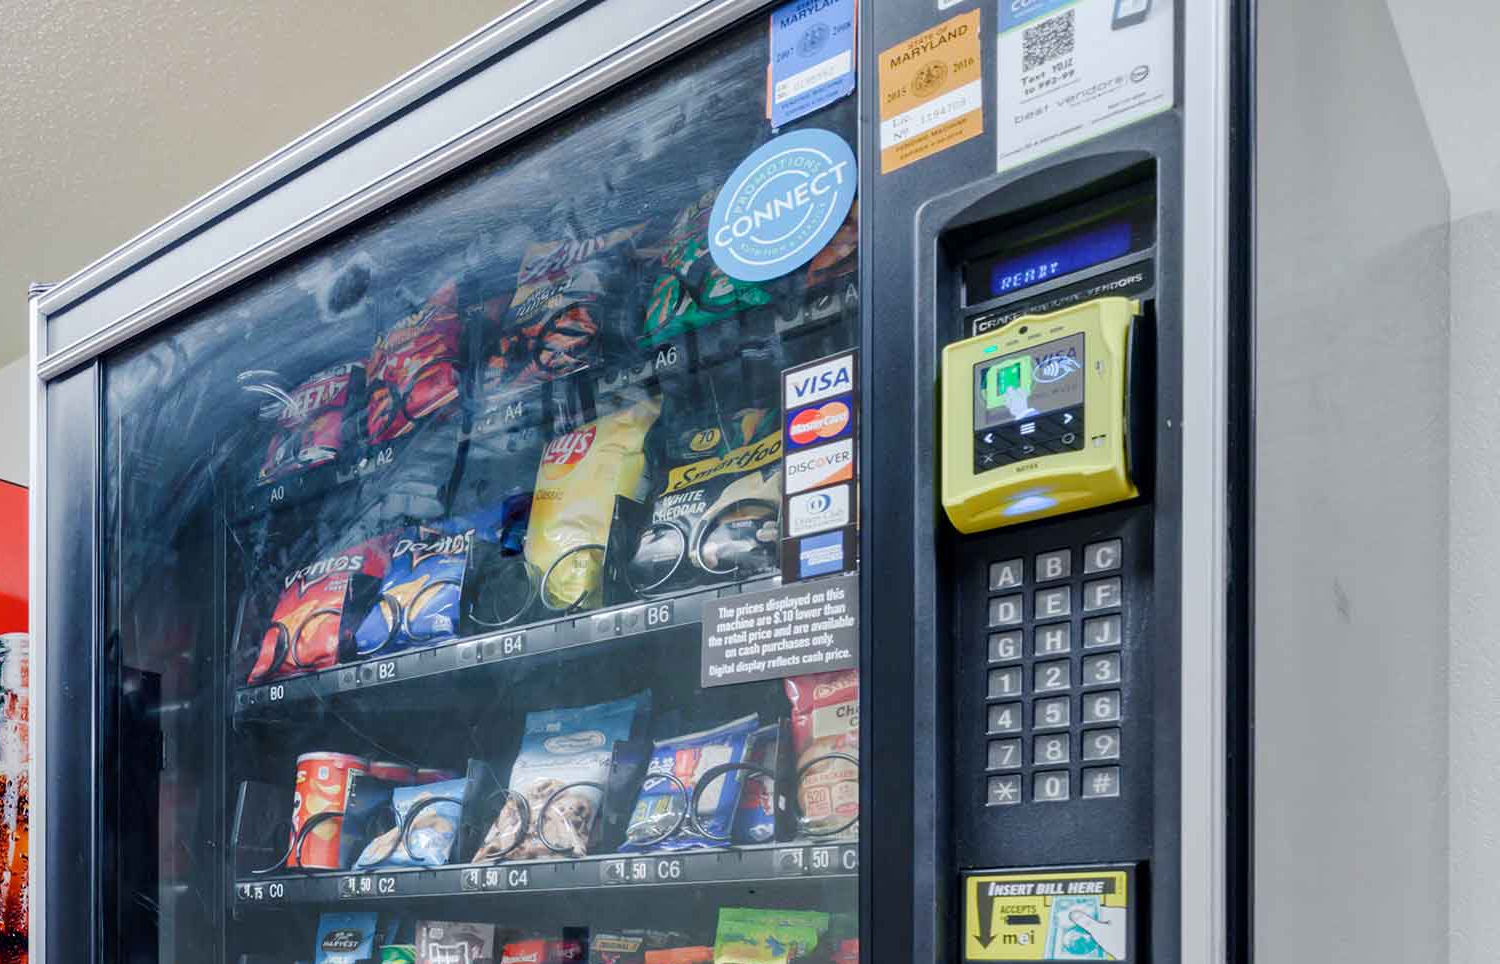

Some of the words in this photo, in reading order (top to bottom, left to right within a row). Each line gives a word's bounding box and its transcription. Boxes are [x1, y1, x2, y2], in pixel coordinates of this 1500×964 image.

[889, 24, 968, 69] MARYLAND
[715, 161, 847, 247] CONNECT
[1000, 261, 1060, 291] READY
[655, 344, 677, 369] A6
[793, 367, 850, 398] VISA
[505, 402, 522, 420] A4
[376, 448, 393, 466] A2
[674, 438, 782, 489] Smartfoo
[788, 450, 850, 476] DISCOVER
[270, 486, 284, 503] A0
[661, 489, 705, 508] WHITE
[651, 502, 707, 524] CHEDDAR
[999, 566, 1014, 586] A
[1047, 557, 1061, 576] B
[1095, 547, 1112, 568] C
[647, 605, 669, 625] B6
[719, 607, 734, 619] The
[736, 603, 764, 620] prices
[766, 593, 810, 611] displayed
[812, 595, 824, 605] on
[826, 588, 844, 600] this
[1000, 603, 1013, 621] D
[1047, 594, 1060, 613] E
[1096, 585, 1110, 605] F
[717, 618, 755, 632] machine
[756, 617, 772, 626] are
[773, 610, 793, 624] $.10
[795, 607, 821, 620] lower
[824, 604, 845, 616] than
[503, 636, 522, 653] B4
[709, 636, 722, 648] the
[724, 632, 747, 645] retail
[749, 629, 772, 644] price
[773, 625, 791, 637] and
[793, 623, 809, 633] are
[811, 617, 854, 631] available
[999, 638, 1014, 657] G
[1046, 631, 1061, 651] H
[1096, 622, 1108, 642] J
[725, 647, 736, 658] on
[738, 643, 760, 656] cash
[762, 637, 810, 656] purchases
[812, 633, 834, 646] only.
[379, 663, 396, 679] B2
[709, 663, 734, 677] Digital
[736, 659, 766, 673] display
[767, 655, 799, 668] reflects
[802, 652, 823, 663] cash
[825, 649, 851, 663] price.
[1000, 675, 1010, 692] 1
[1047, 668, 1060, 687] 2
[1096, 660, 1110, 680] 3
[270, 685, 284, 700] B0
[998, 710, 1012, 727] 4
[1046, 704, 1060, 723] 5
[1095, 698, 1109, 717] 6
[1001, 746, 1013, 764] 7
[1047, 740, 1061, 759] 8
[1096, 736, 1112, 755] 9
[1046, 777, 1060, 796] 0
[1093, 774, 1110, 793] #
[509, 870, 528, 886] C4
[658, 860, 681, 879] C6
[269, 883, 284, 898] C0
[378, 877, 395, 893] C2
[988, 882, 1035, 896] INSERT
[1036, 882, 1064, 895] BILL
[1068, 881, 1105, 894] HERE
[1000, 905, 1037, 914] ACCEPTS
